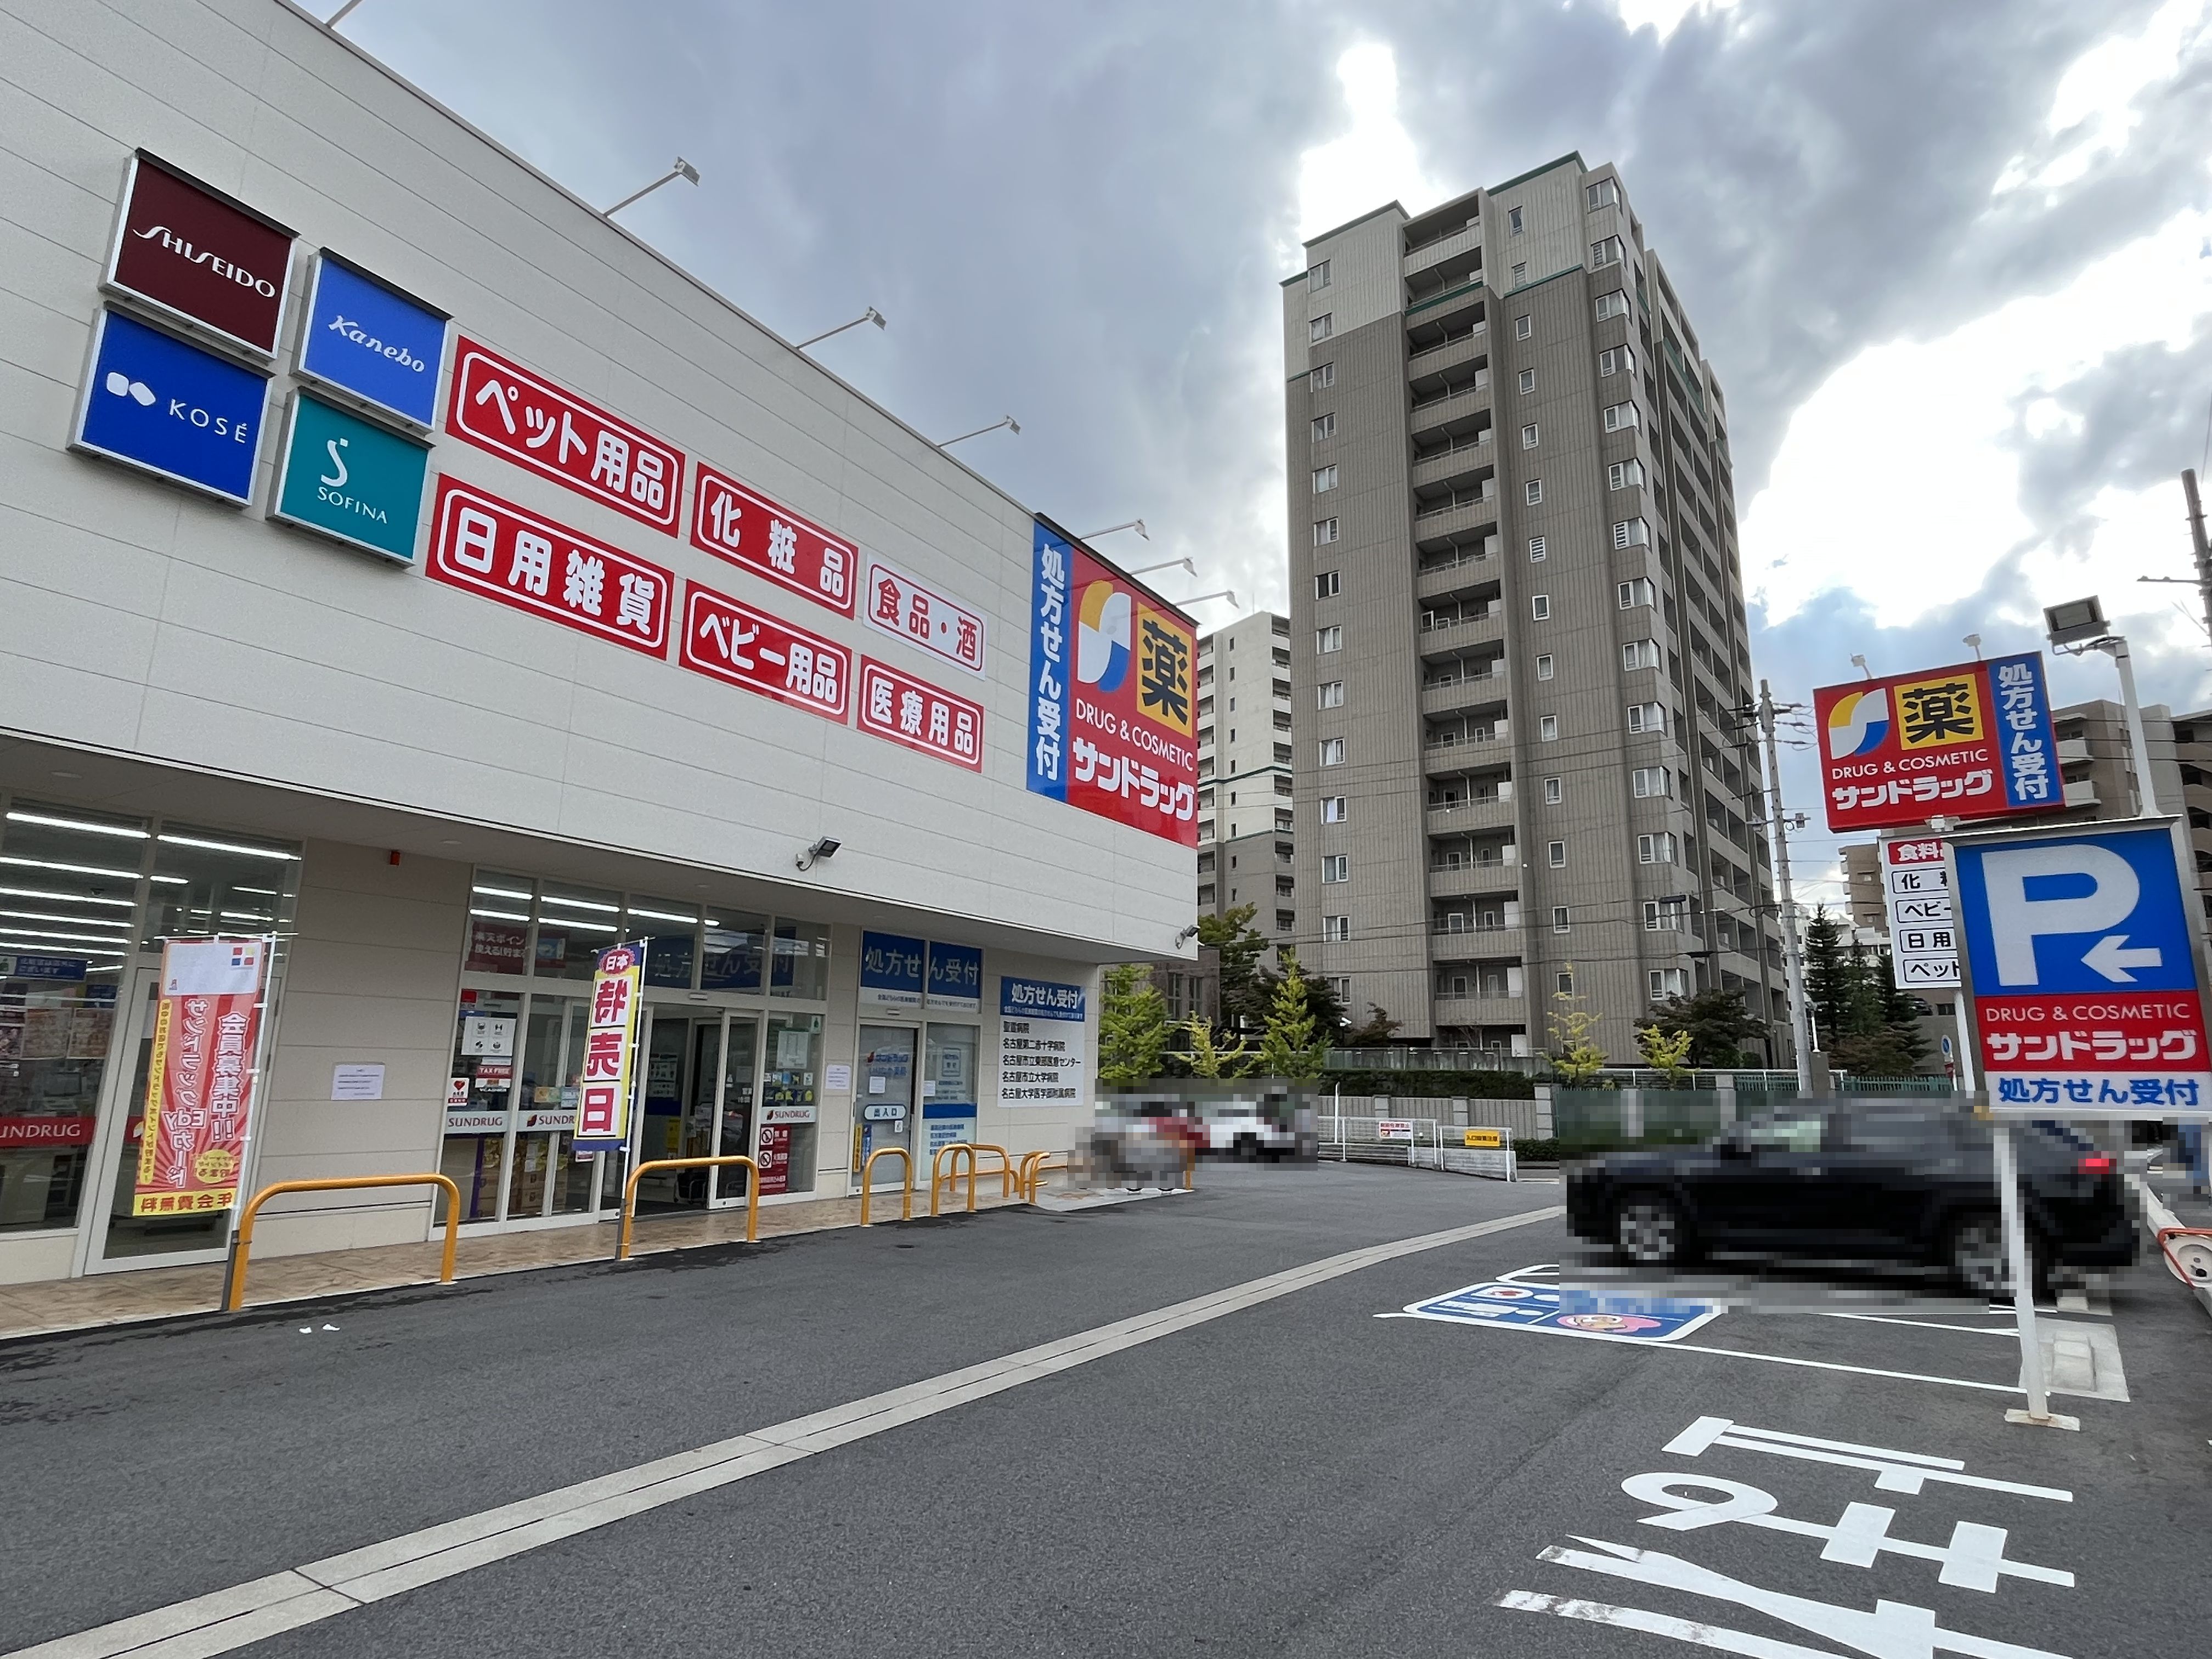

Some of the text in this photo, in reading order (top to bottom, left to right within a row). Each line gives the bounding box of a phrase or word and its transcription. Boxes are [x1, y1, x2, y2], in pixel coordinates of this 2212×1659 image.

[133, 225, 276, 298] SHISEIDO
[328, 314, 425, 373] Kanebo
[170, 401, 247, 443] KOSÉ
[476, 379, 663, 510] ペット用品
[317, 487, 388, 524] SOFINA
[455, 507, 654, 635] 日用雑貨
[710, 490, 844, 598] 化粧品
[700, 613, 837, 703] ベビー用品
[1036, 543, 1065, 781] 処方せん受付
[1142, 619, 1188, 726] 薬
[872, 676, 973, 755] 医療用品
[1076, 698, 1194, 771] DRUG & COSMETIC
[1902, 681, 1976, 744] 薬
[1997, 663, 2049, 801] 処方せん受付
[1073, 736, 1195, 822] サンドラッグ
[1831, 769, 1993, 810] サンドラッグ
[1832, 748, 1988, 780] DRUG & COSMETIC
[1898, 841, 1944, 862] 食料
[1981, 843, 2141, 986] P
[865, 946, 979, 985] 処方せん受付
[1012, 983, 1079, 1009] 処方せん受付
[1986, 1003, 2190, 1022] DRUG & COSMETIC
[1986, 1030, 2197, 1061] サンドラッグ
[448, 1117, 503, 1127] SUNDRUG
[775, 1110, 810, 1120] SUNDRUG
[1999, 1078, 2200, 1107] 処方せん受付
